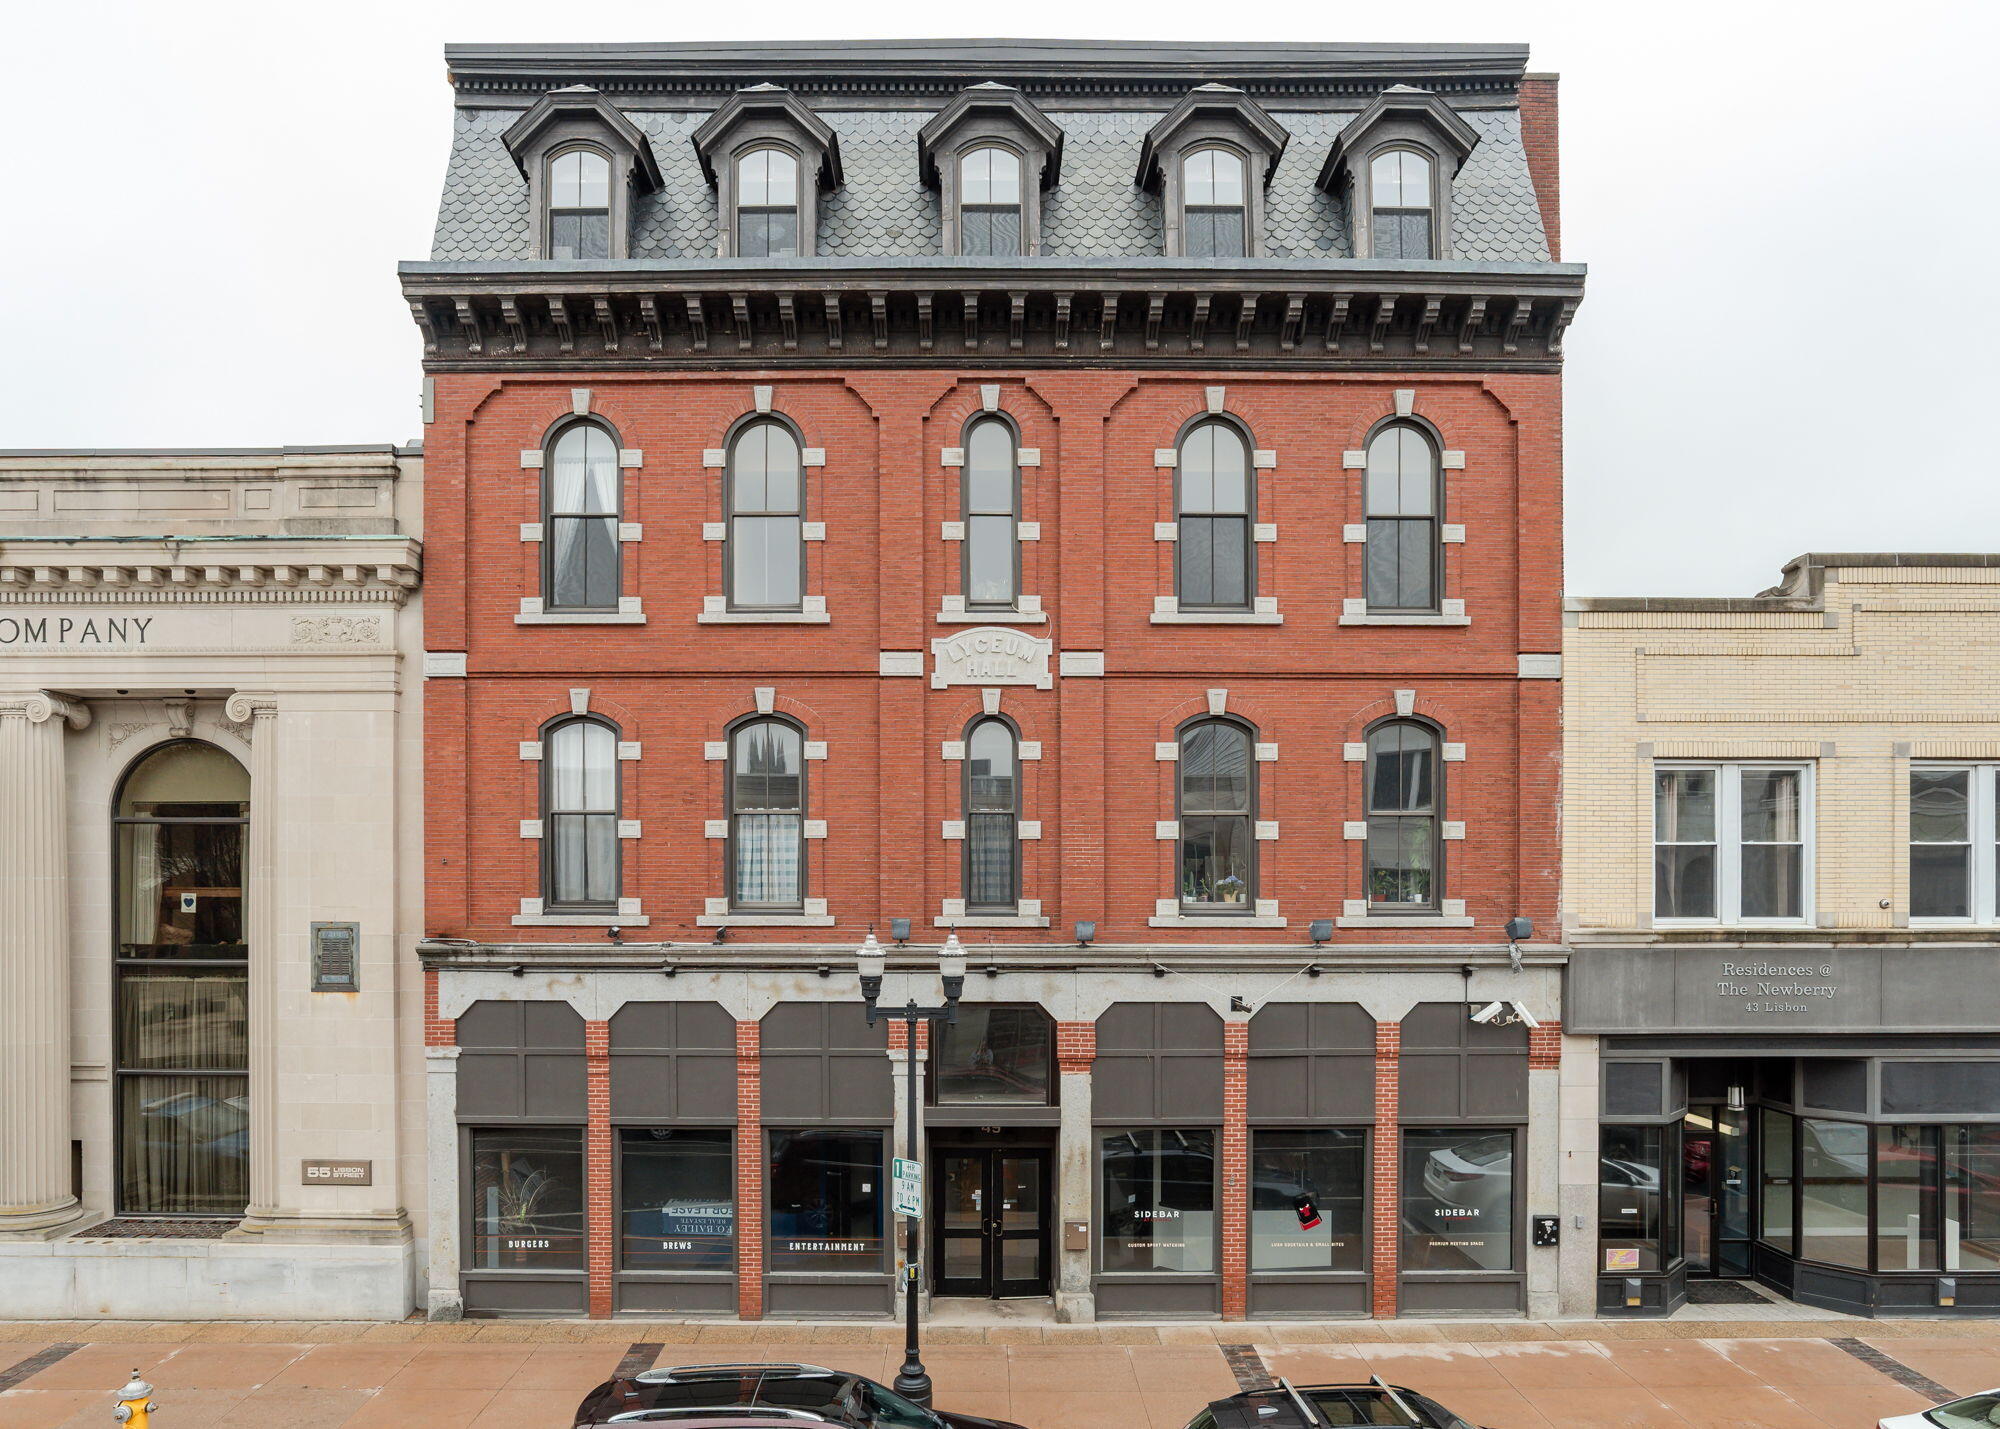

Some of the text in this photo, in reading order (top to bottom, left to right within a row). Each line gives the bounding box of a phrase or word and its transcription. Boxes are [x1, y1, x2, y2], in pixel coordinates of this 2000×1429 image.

[946, 635, 1037, 663] LYCEUM
[966, 660, 1017, 678] HALL
[1722, 962, 1832, 977] Residences @
[1717, 982, 1838, 999] The Newberry
[1745, 1002, 1808, 1012] 43 Lisbon
[307, 1166, 331, 1178] 55
[895, 1161, 900, 1177] 1
[907, 1164, 916, 1172] HR
[902, 1171, 921, 1182] PARKING
[901, 1181, 915, 1192] 9 AM
[896, 1192, 904, 1203] TO
[912, 1195, 920, 1207] PM
[1134, 1210, 1180, 1218] SIDEBAR
[1434, 1208, 1480, 1216] SIDEBAR
[674, 1224, 713, 1233] BAILEY
[508, 1240, 549, 1248] BURGERS
[663, 1241, 692, 1250] BREWS
[789, 1242, 865, 1251] ENTERTAINMENT
